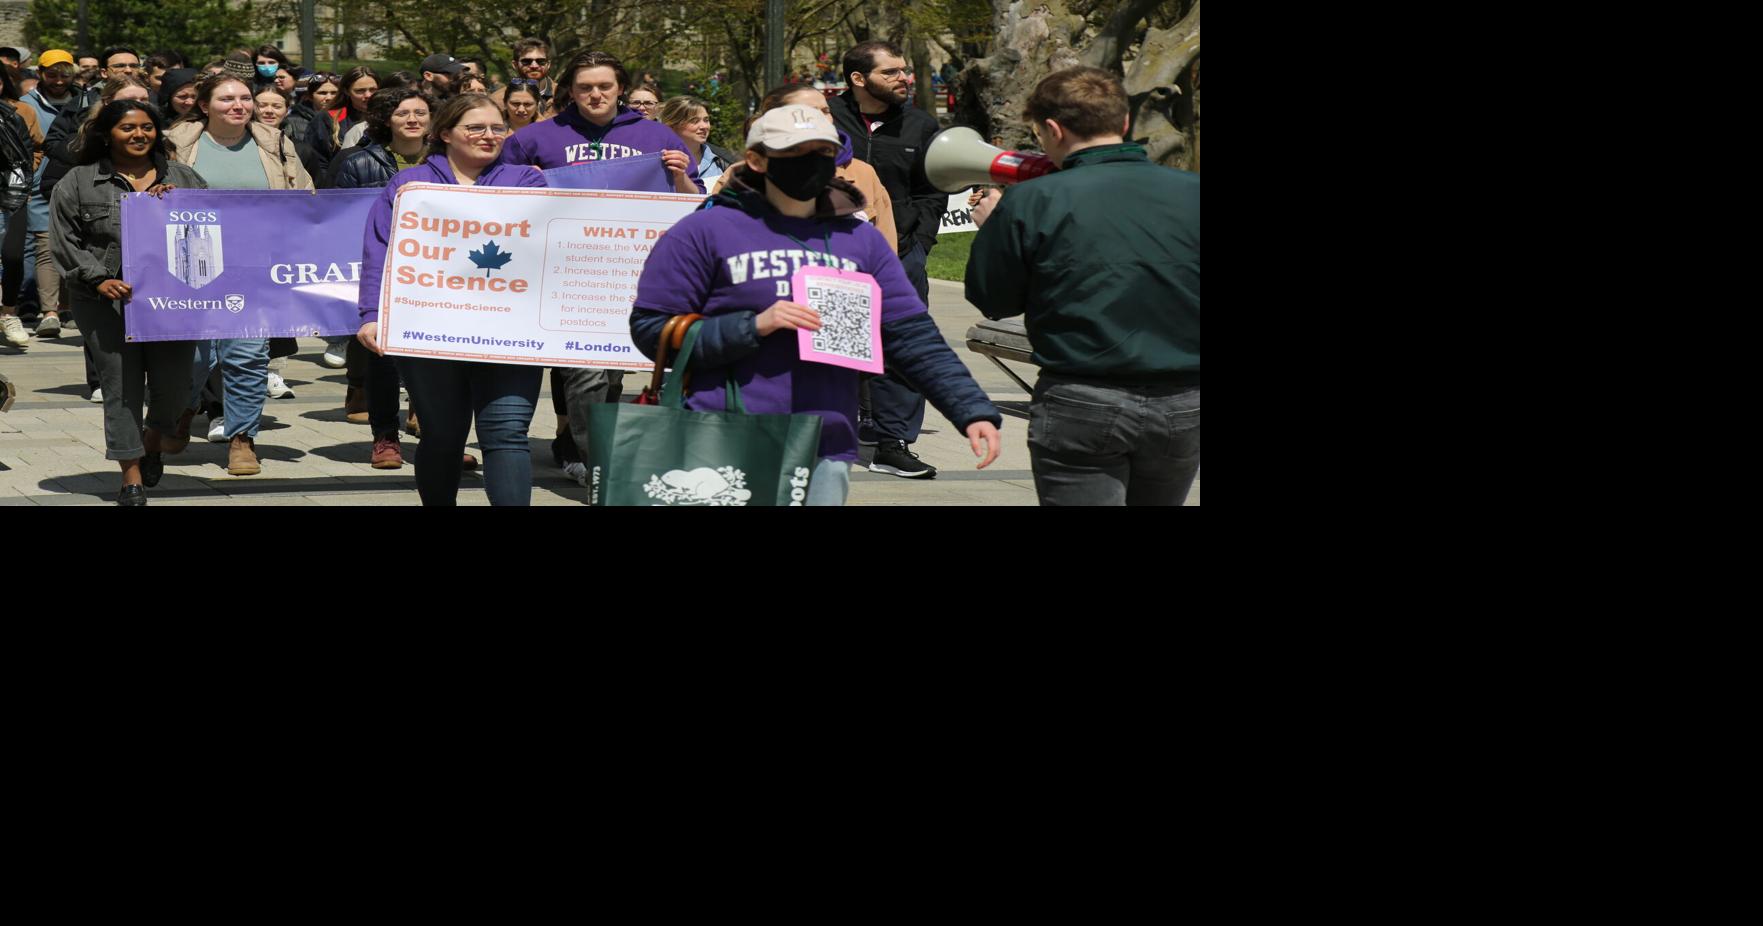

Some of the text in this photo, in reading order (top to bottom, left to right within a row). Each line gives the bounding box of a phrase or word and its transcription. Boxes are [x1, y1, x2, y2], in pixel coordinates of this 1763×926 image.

[169, 210, 217, 222] SOGS
[941, 207, 974, 227] REN
[399, 211, 531, 239] Support
[583, 226, 639, 239] WHAT
[397, 238, 456, 261] Our
[567, 242, 611, 251] Increase
[614, 243, 630, 251] the
[565, 255, 604, 263] student
[564, 266, 608, 275] Increase
[611, 268, 628, 276] the
[396, 265, 529, 293] Science
[562, 280, 627, 290] scholarships
[148, 296, 222, 310] Western
[562, 292, 607, 301] Increase
[609, 293, 626, 302] the
[394, 296, 511, 313] #SupportOurScience
[561, 304, 628, 315] for increased
[559, 318, 607, 327] postdocs
[402, 330, 631, 353] #WesternUniversity #London
